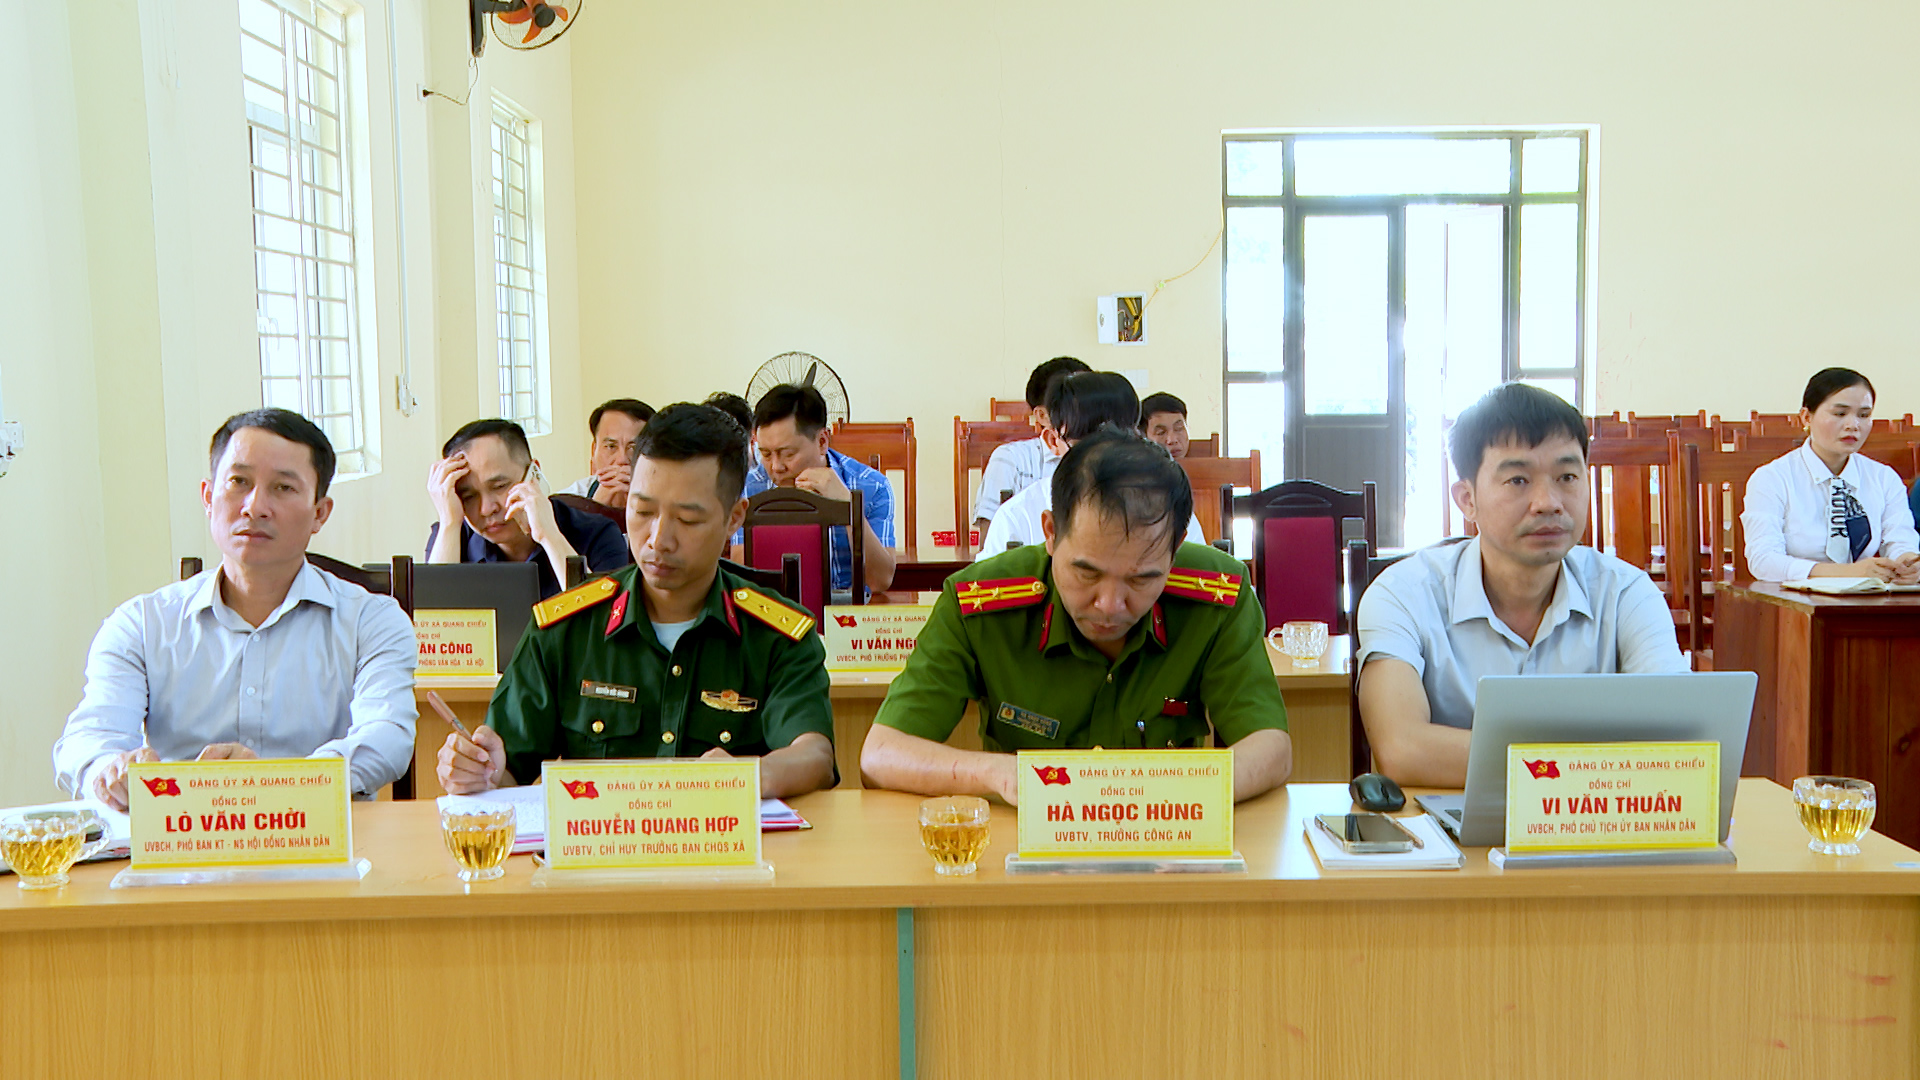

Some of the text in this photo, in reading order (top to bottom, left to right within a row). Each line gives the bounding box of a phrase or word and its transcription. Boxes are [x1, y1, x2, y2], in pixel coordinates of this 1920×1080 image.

[417, 641, 472, 654] ĂN CÔNG
[851, 640, 862, 649] VI
[867, 636, 891, 649] VĂN
[1079, 766, 1108, 777] ĐẢNG
[1131, 767, 1144, 777] XÃ
[1149, 767, 1183, 777] QUANG
[1569, 761, 1597, 770] ĐẢNG
[1619, 760, 1631, 769] XÃ
[1636, 760, 1670, 769] QUANG
[189, 777, 219, 788] ĐẢNG
[242, 777, 255, 786] XÃ
[260, 777, 296, 787] QUANG
[607, 780, 635, 791] ĐẢNG
[658, 780, 671, 789] XÃ
[676, 780, 710, 789] QUANG
[1617, 778, 1631, 789] CHÍ
[1129, 786, 1144, 796] CHÍ
[241, 796, 256, 806] CHÍ
[657, 799, 672, 809] CHÍ
[1542, 790, 1682, 815] VI VĂN THUẤN
[1048, 800, 1203, 824] HÀ NGỌC HÙNG
[166, 811, 192, 832] LÒ
[201, 810, 245, 831] VĂN
[567, 813, 739, 836] NGUYỄN QUANG HỢP
[1528, 823, 1556, 835] UVBCH,
[1561, 821, 1576, 834] PHÓ
[1580, 820, 1596, 833] CHỦ
[1600, 821, 1617, 835] TỊCH
[1635, 821, 1650, 831] BAN
[1654, 819, 1676, 831] NHÂN
[1679, 819, 1696, 831] DÂN
[1055, 828, 1191, 843] UVBTV, TRƯỞNG CÔNG AN
[145, 841, 173, 853] UVBCH,
[177, 838, 193, 850] PHÓ
[197, 840, 212, 850] BAN
[215, 840, 224, 849] KT
[234, 839, 244, 849] NS
[248, 836, 261, 849] HỘI
[289, 837, 310, 848] NHÂN
[314, 834, 330, 846] DÂN
[563, 845, 595, 857] UVBTV,
[619, 845, 637, 854] HUY
[642, 840, 678, 854] TRƯỞNG
[682, 843, 700, 853] BAN
[704, 842, 729, 852] CHQS
[733, 840, 745, 852] XÃ
